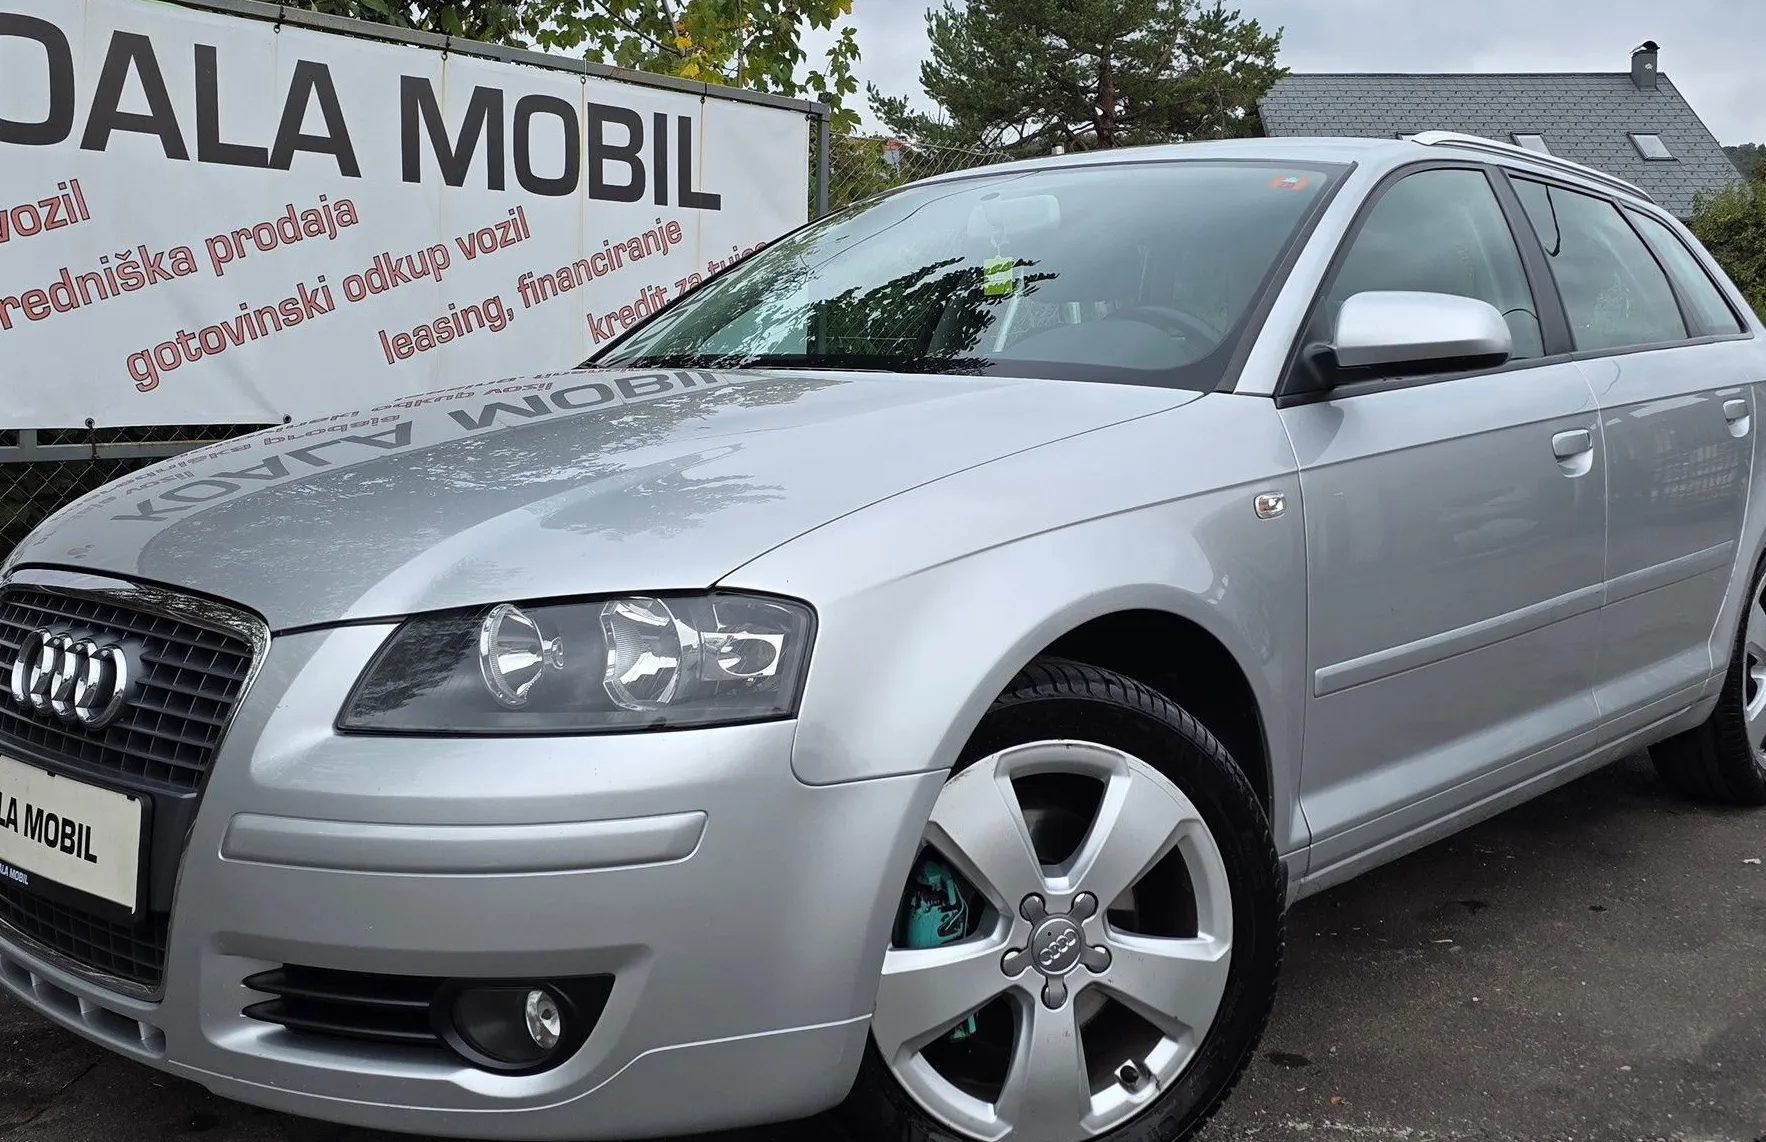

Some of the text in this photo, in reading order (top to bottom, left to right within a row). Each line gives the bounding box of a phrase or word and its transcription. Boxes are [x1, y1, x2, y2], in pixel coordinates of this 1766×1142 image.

[400, 74, 721, 211] MOBIL
[0, 194, 360, 331] redniška prodaja
[126, 275, 335, 392] gotovinski
[342, 242, 451, 303] odkup
[455, 205, 531, 261] vozil
[378, 293, 515, 365] leasing,
[517, 217, 683, 308] financiranje
[9, 867, 29, 885] MOBIL
[24, 803, 98, 864] MOBIL
